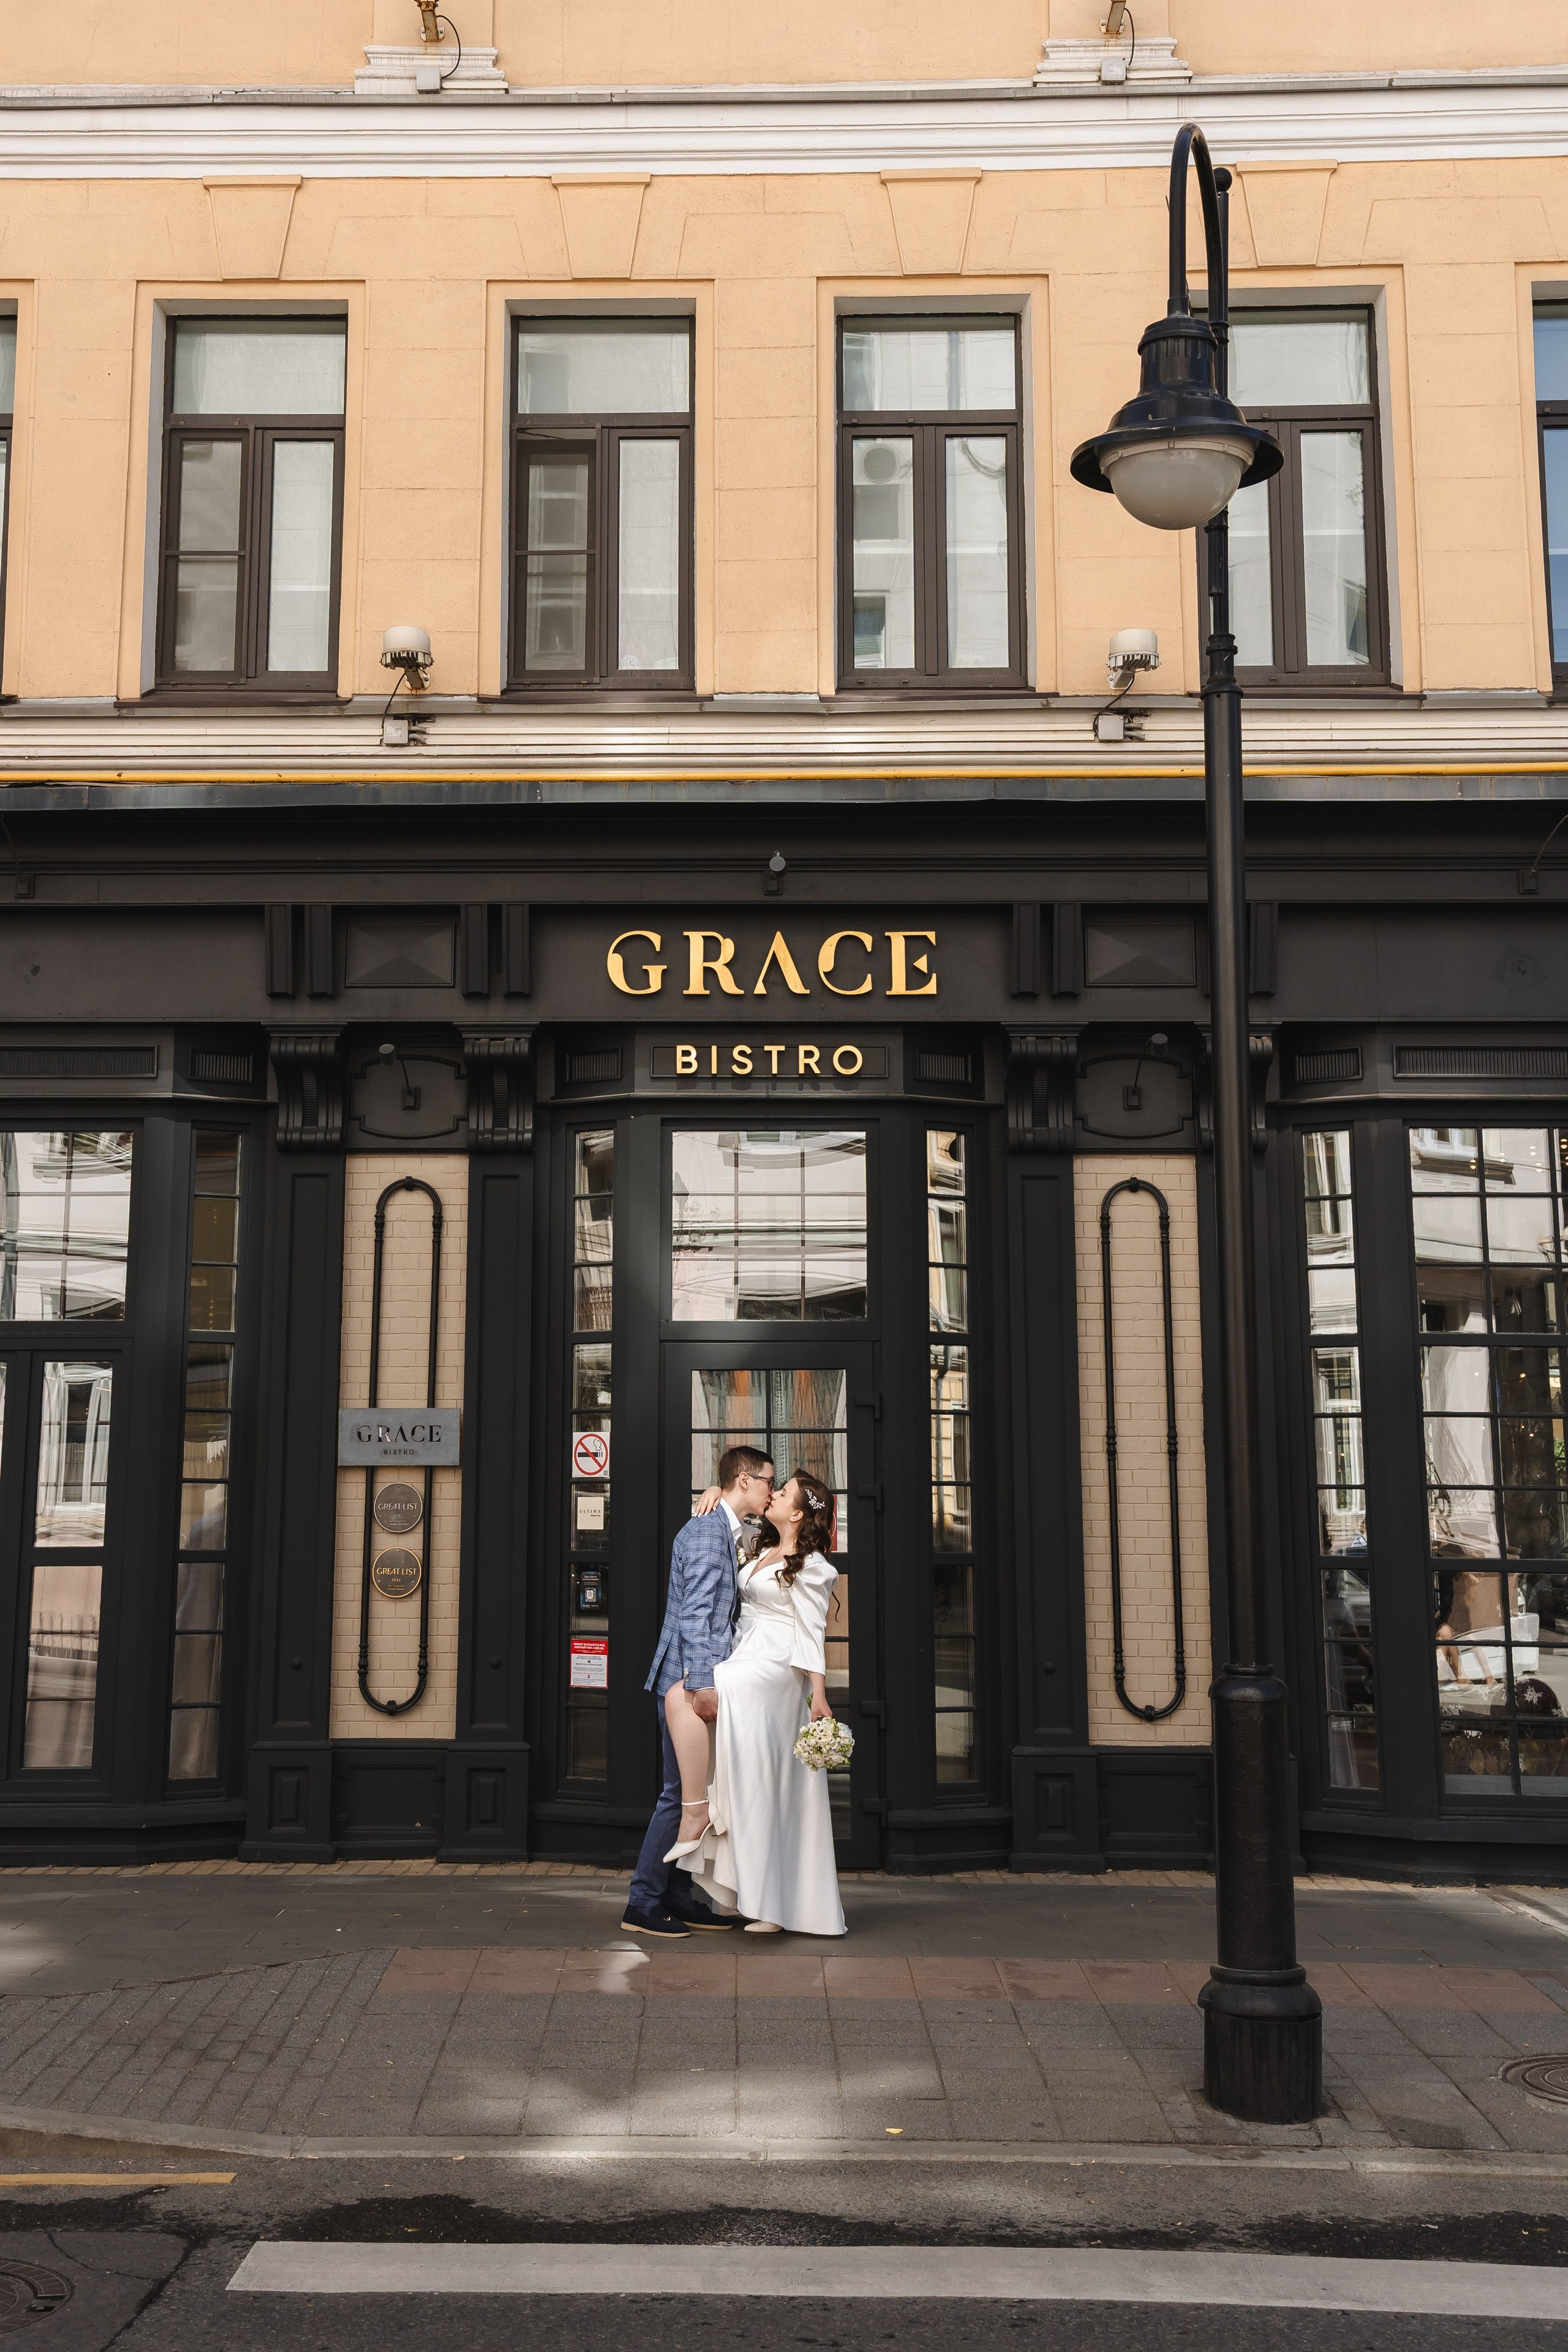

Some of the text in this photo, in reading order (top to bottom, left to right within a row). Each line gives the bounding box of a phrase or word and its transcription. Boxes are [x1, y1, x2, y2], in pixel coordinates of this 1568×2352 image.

[607, 930, 937, 995] GRACE
[676, 1044, 863, 1075] BISTRO
[357, 1425, 442, 1442] GRACE
